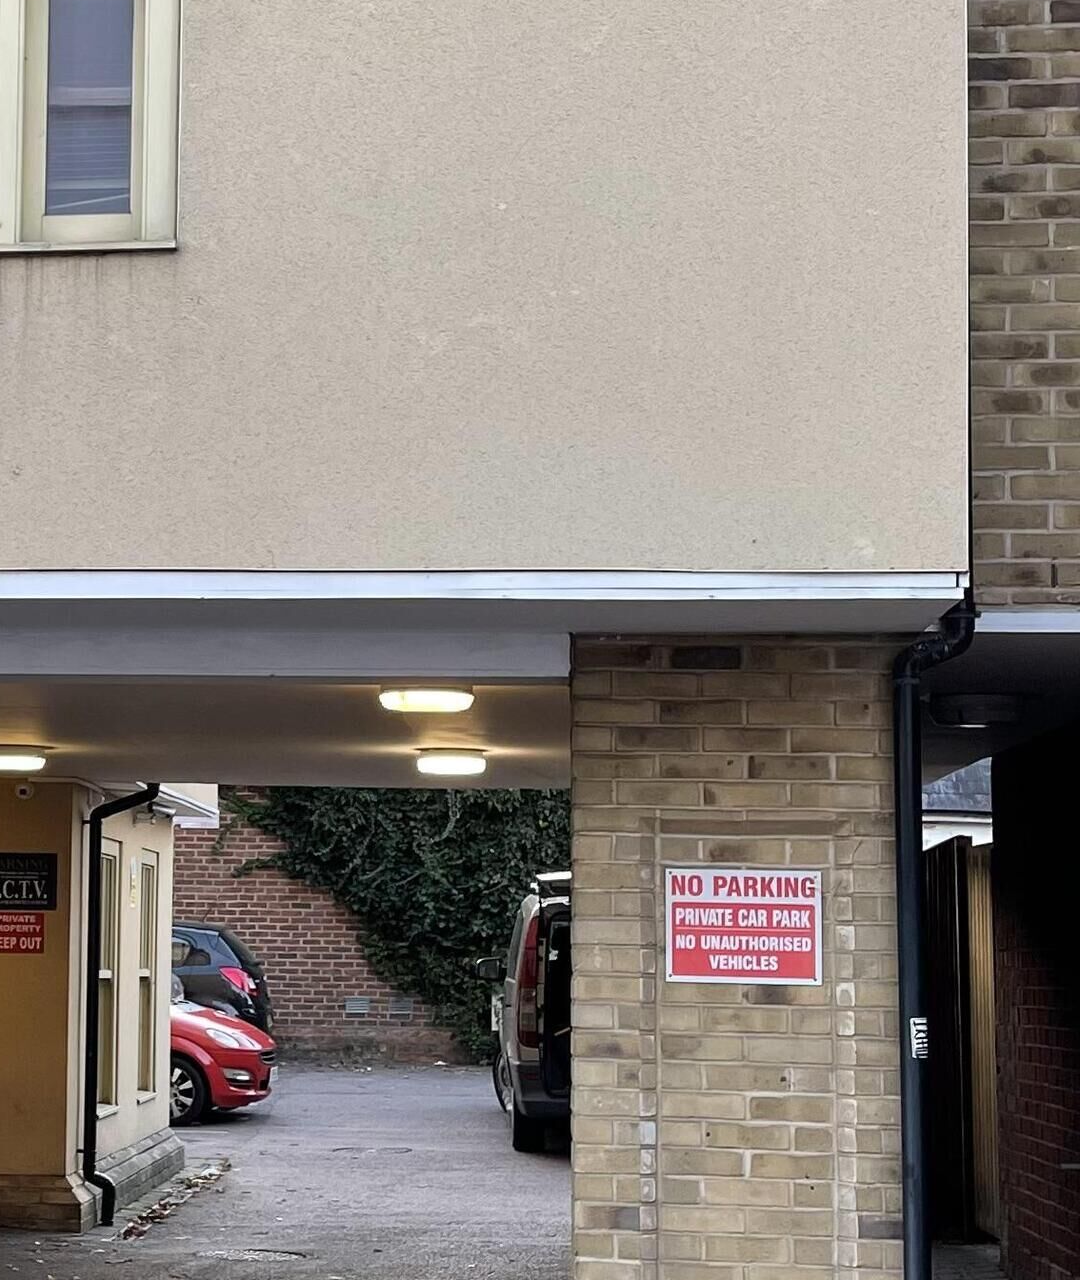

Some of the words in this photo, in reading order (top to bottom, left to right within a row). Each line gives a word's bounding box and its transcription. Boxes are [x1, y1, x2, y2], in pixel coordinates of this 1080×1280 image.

[671, 875, 703, 896] NO
[713, 876, 816, 898] PARKING
[675, 908, 733, 926] PRIVATE
[738, 909, 767, 927] CAR
[772, 910, 811, 928] PARK
[20, 937, 42, 950] OUT
[675, 935, 695, 949] NO
[701, 935, 812, 952] UNAUTHORISED
[709, 954, 778, 971] VEHICLES
